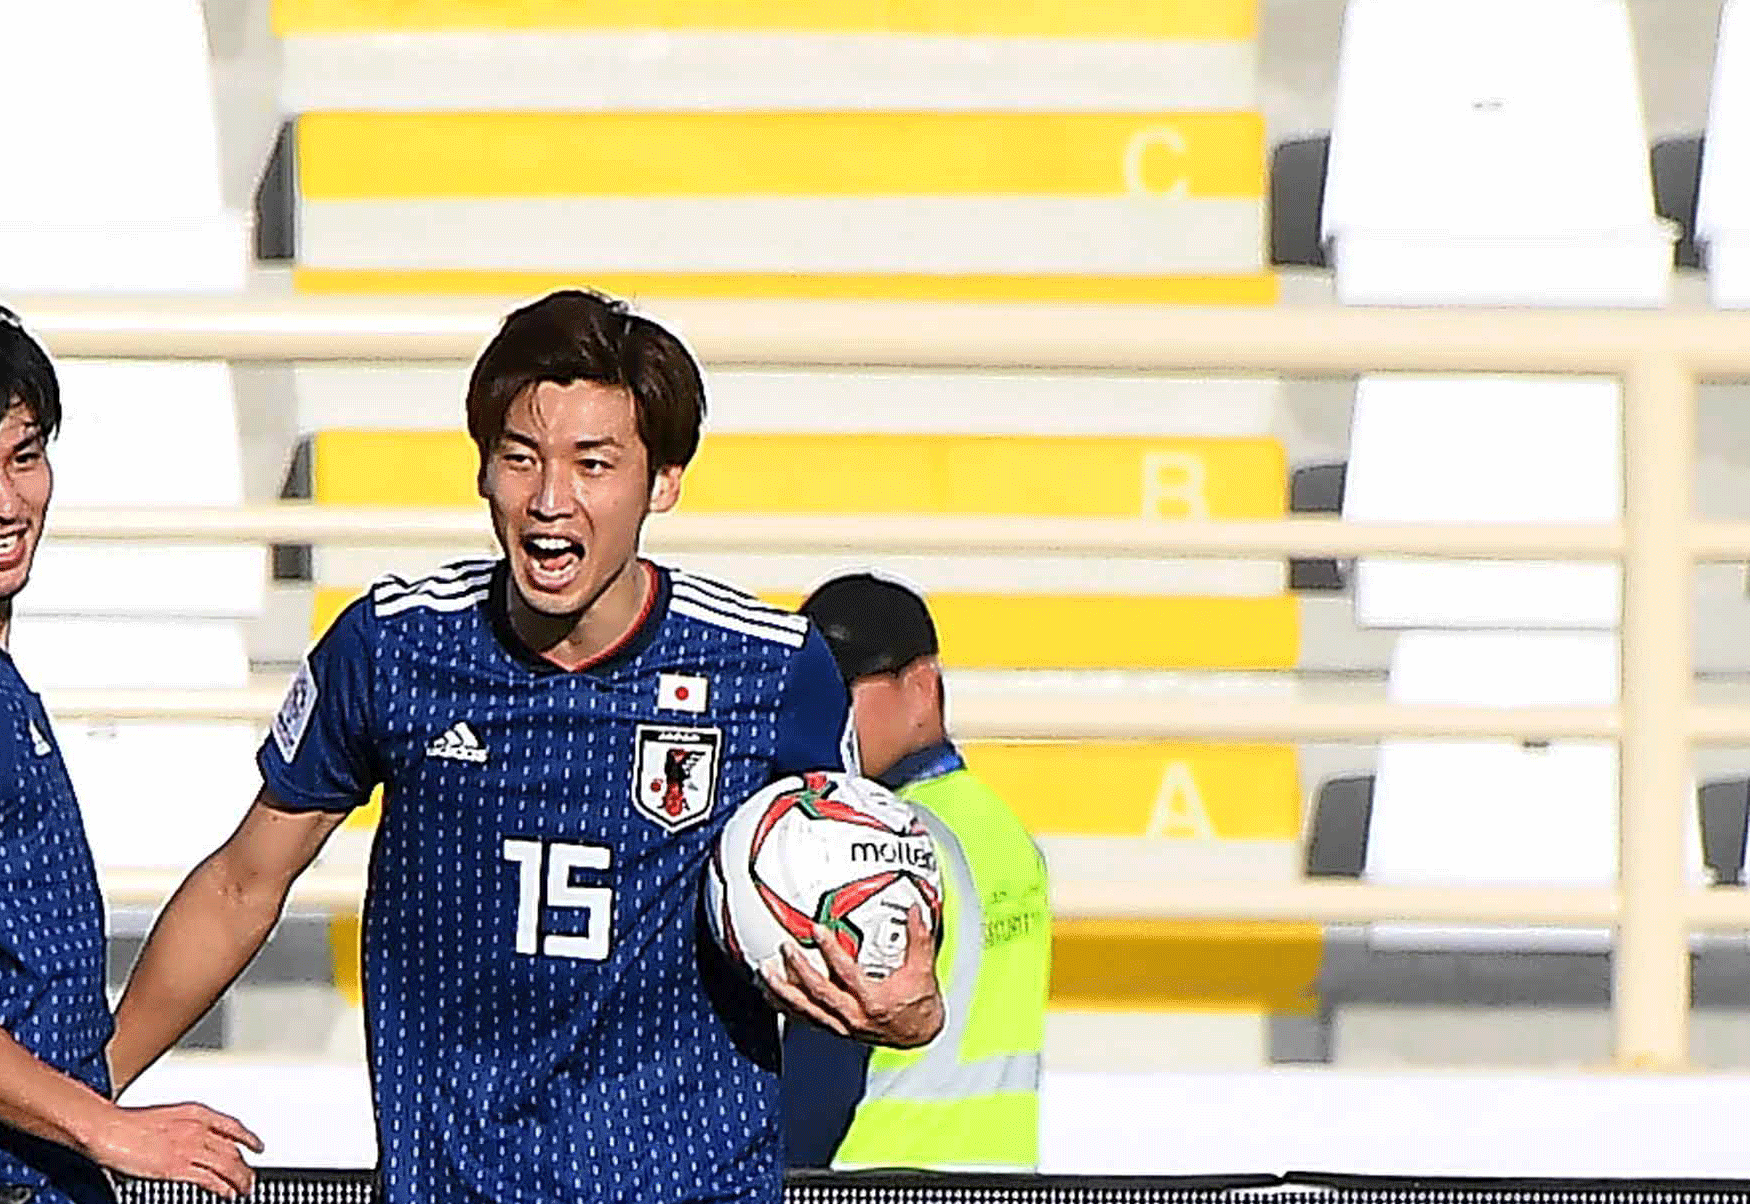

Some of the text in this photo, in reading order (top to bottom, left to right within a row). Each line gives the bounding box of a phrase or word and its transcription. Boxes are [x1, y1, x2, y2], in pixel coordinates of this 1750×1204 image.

[1123, 125, 1190, 201] C
[1141, 451, 1209, 523] B
[1144, 760, 1216, 841] A
[504, 838, 613, 961] 15
